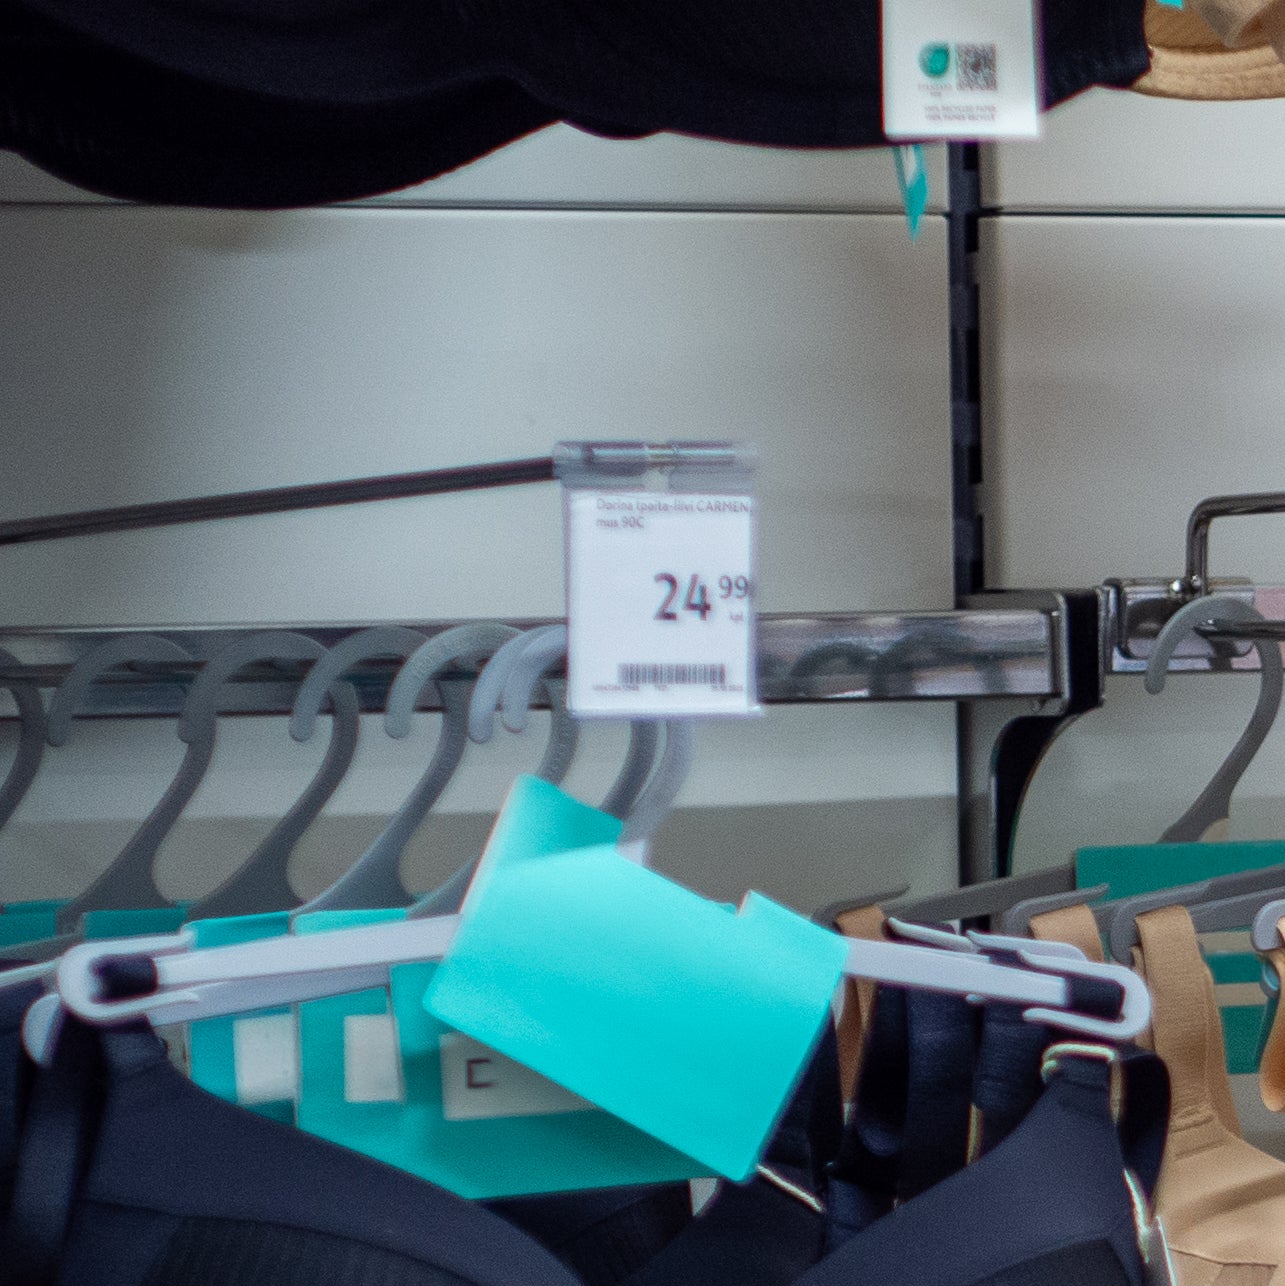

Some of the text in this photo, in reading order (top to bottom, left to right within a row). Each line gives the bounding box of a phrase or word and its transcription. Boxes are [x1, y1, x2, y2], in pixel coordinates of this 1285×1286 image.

[696, 501, 749, 513] CARMEN
[653, 572, 751, 622] 24 99
